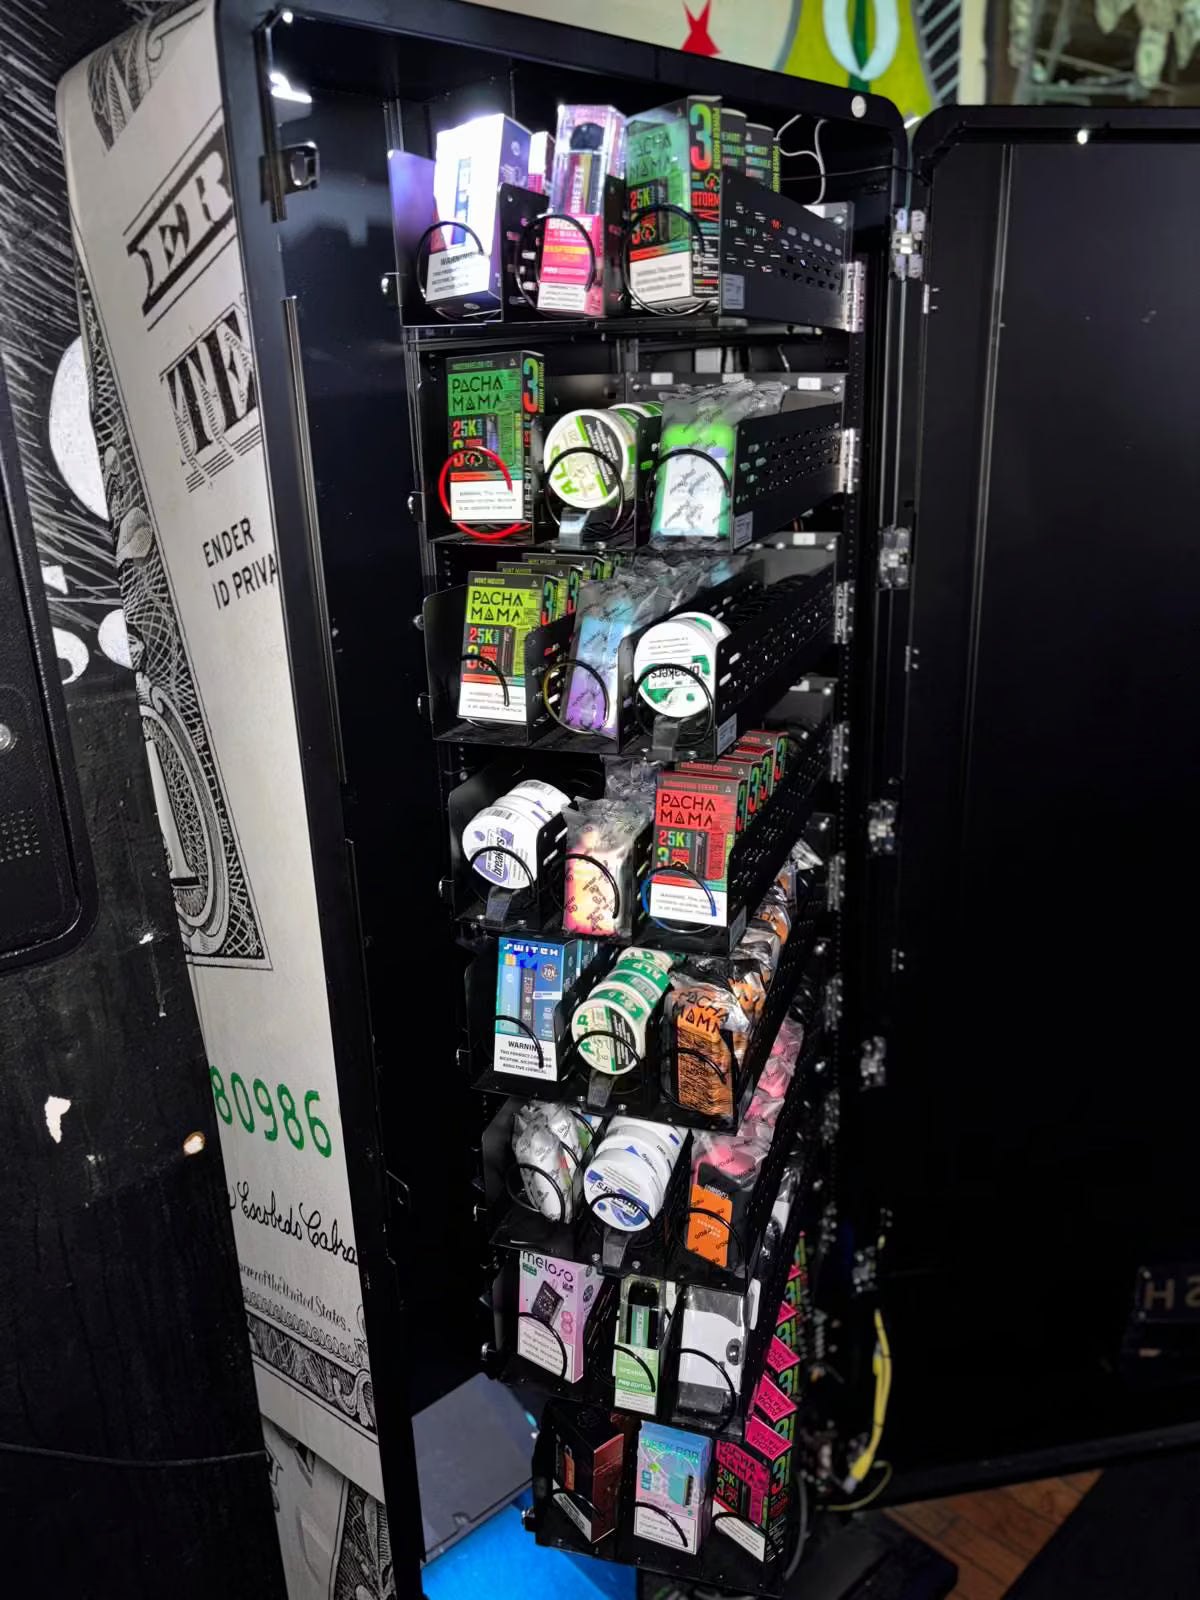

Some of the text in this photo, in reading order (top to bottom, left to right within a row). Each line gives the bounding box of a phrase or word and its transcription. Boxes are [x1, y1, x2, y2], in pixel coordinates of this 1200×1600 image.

[690, 103, 712, 170] 3
[452, 375, 503, 393] PACHA
[523, 358, 538, 413] 3
[452, 394, 501, 412] MAMA
[202, 517, 255, 569] ENDER
[471, 590, 523, 606] PACHA
[470, 607, 521, 622] MAMA
[661, 793, 716, 812] PACHA
[660, 810, 713, 827] MAMA
[491, 836, 505, 878] breakrs
[504, 943, 558, 957] SWITCH
[576, 1014, 597, 1055] AP
[508, 1040, 545, 1054] WARNIN:
[209, 1065, 332, 1158] 80986
[522, 1251, 574, 1283] meloso
